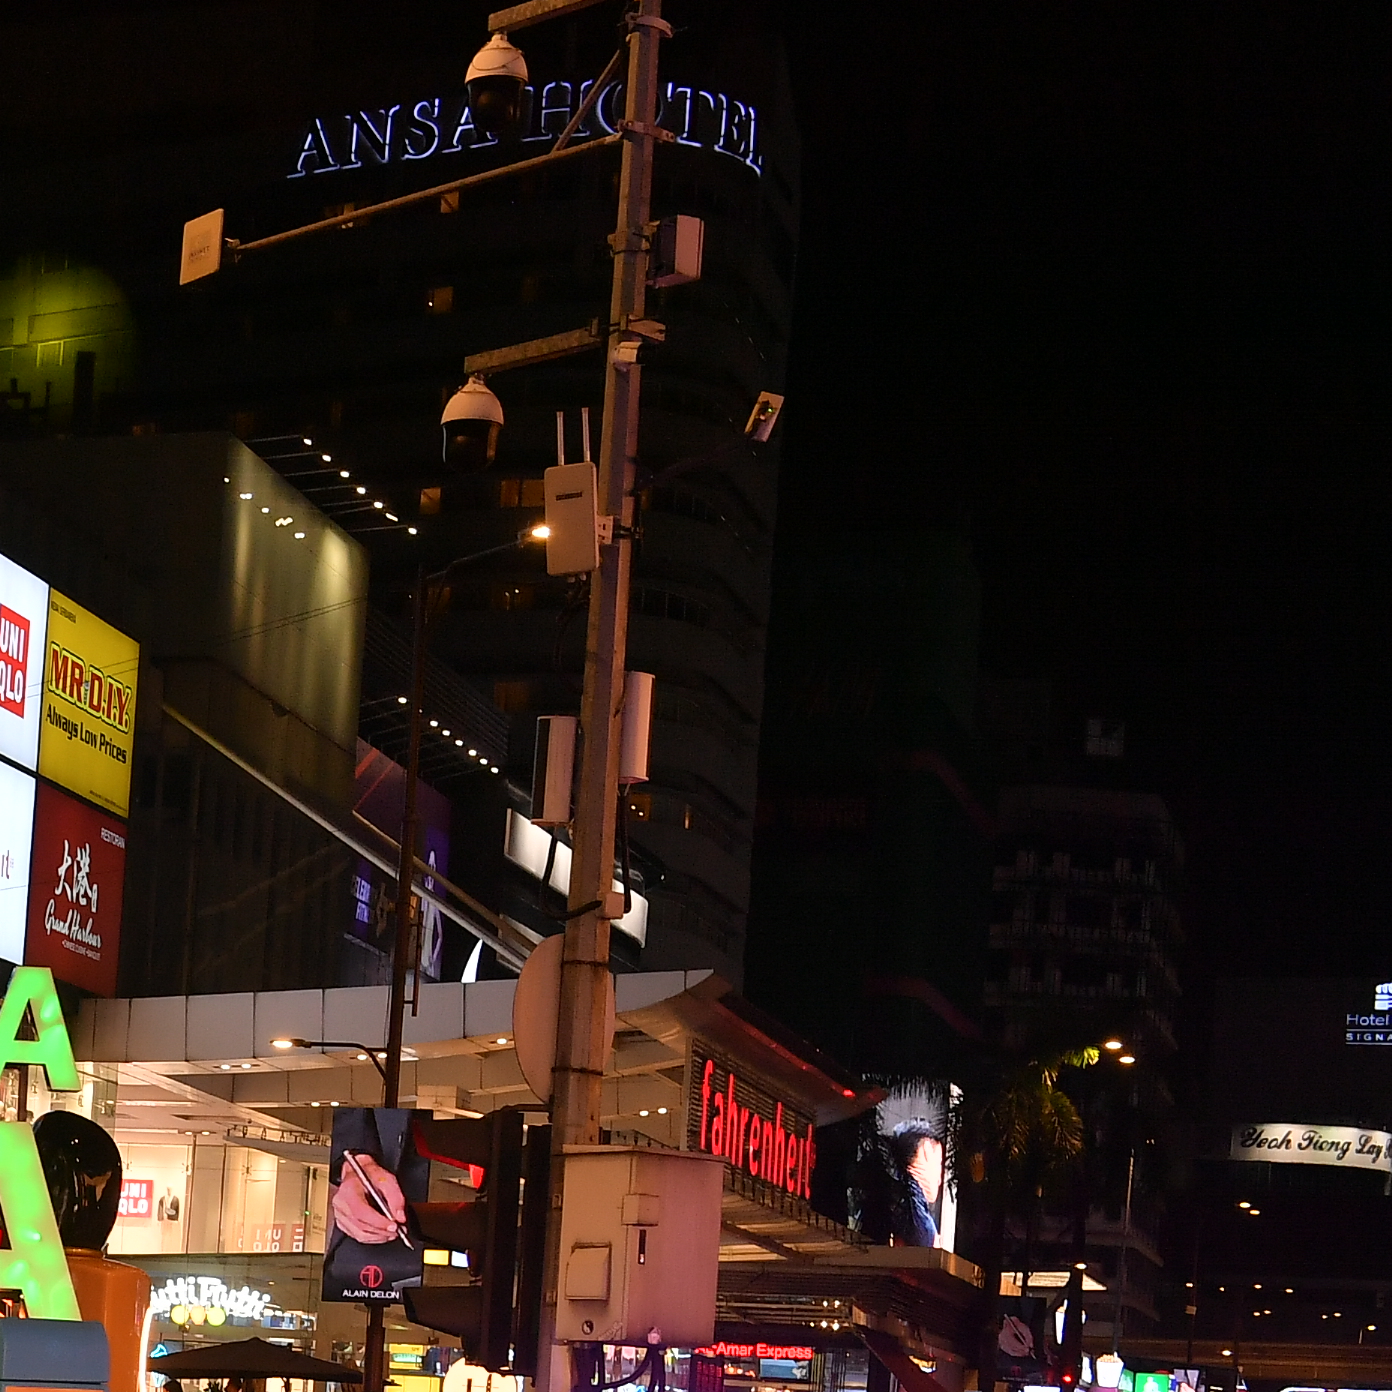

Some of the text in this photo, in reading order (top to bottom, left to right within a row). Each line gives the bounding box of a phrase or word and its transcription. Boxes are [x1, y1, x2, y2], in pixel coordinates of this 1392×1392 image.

[287, 97, 497, 178] ANSA
[46, 702, 127, 764] Always Low Prices
[44, 898, 73, 936] Grand
[69, 908, 102, 949] Harbour
[1346, 1013, 1390, 1026] Hotel
[700, 1059, 813, 1200] fahrenheit
[1241, 1127, 1293, 1151] Yeoh
[1297, 1129, 1352, 1161] Tiong
[1355, 1133, 1384, 1164] Lay
[118, 1198, 149, 1215] QLO
[342, 1289, 400, 1299] ALAIN DELON
[756, 1343, 814, 1360] Express
